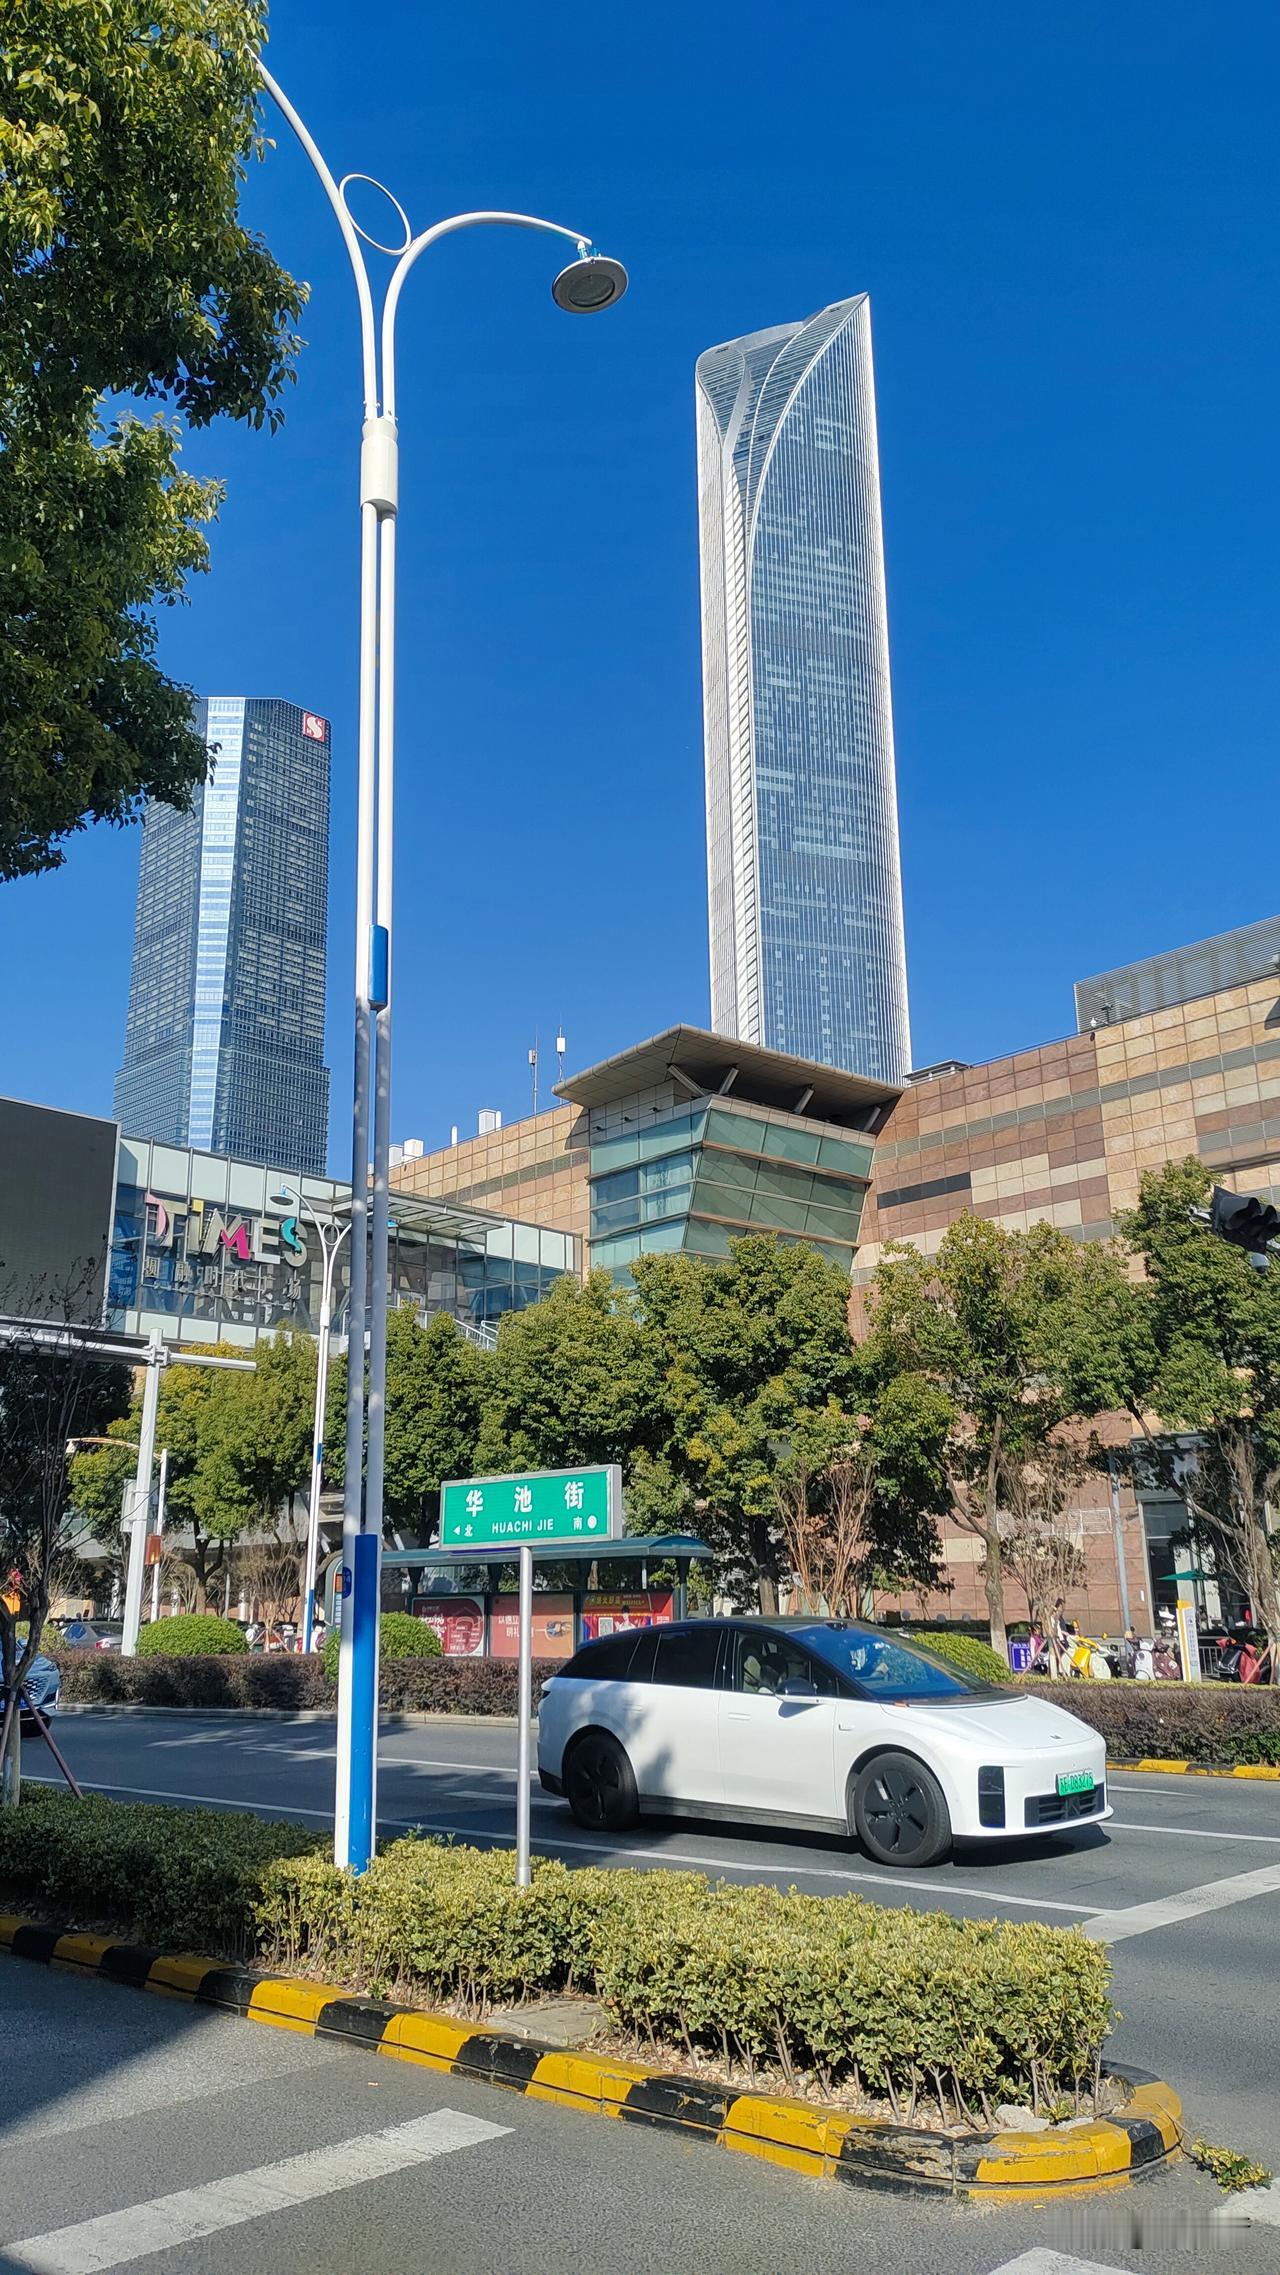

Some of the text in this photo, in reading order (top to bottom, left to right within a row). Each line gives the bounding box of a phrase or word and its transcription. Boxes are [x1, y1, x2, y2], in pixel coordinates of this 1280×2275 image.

[465, 1481, 584, 1518] 华池街
[464, 1524, 474, 1537] 北
[491, 1518, 554, 1534] HUACHI JIE
[573, 1516, 583, 1530] 南
